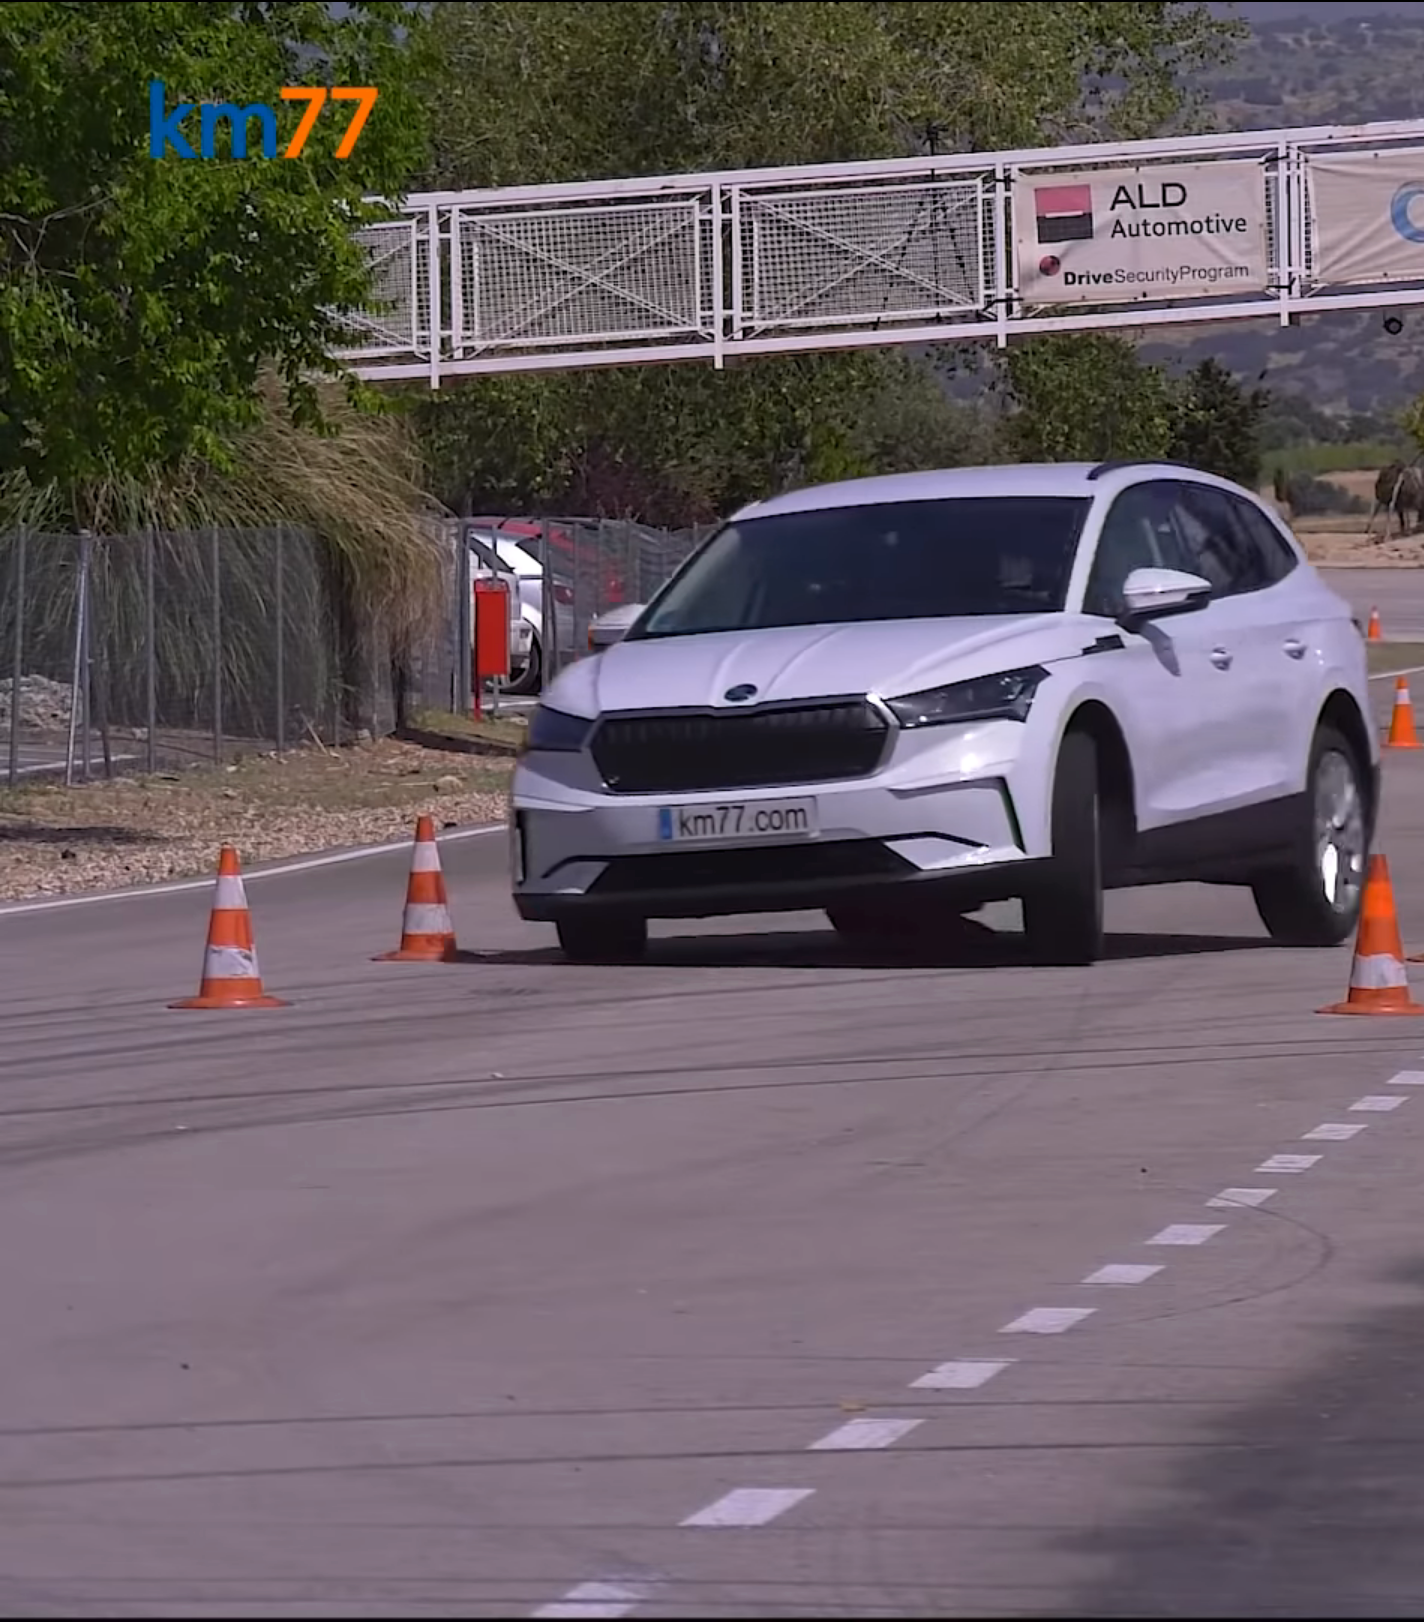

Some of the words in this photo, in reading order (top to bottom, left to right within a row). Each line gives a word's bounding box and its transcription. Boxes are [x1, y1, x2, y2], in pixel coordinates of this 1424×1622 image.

[1109, 182, 1187, 211] ALD
[1110, 213, 1247, 238] Automotive
[1063, 265, 1249, 286] DriveSecurityProgram
[679, 805, 808, 838] km77.com
